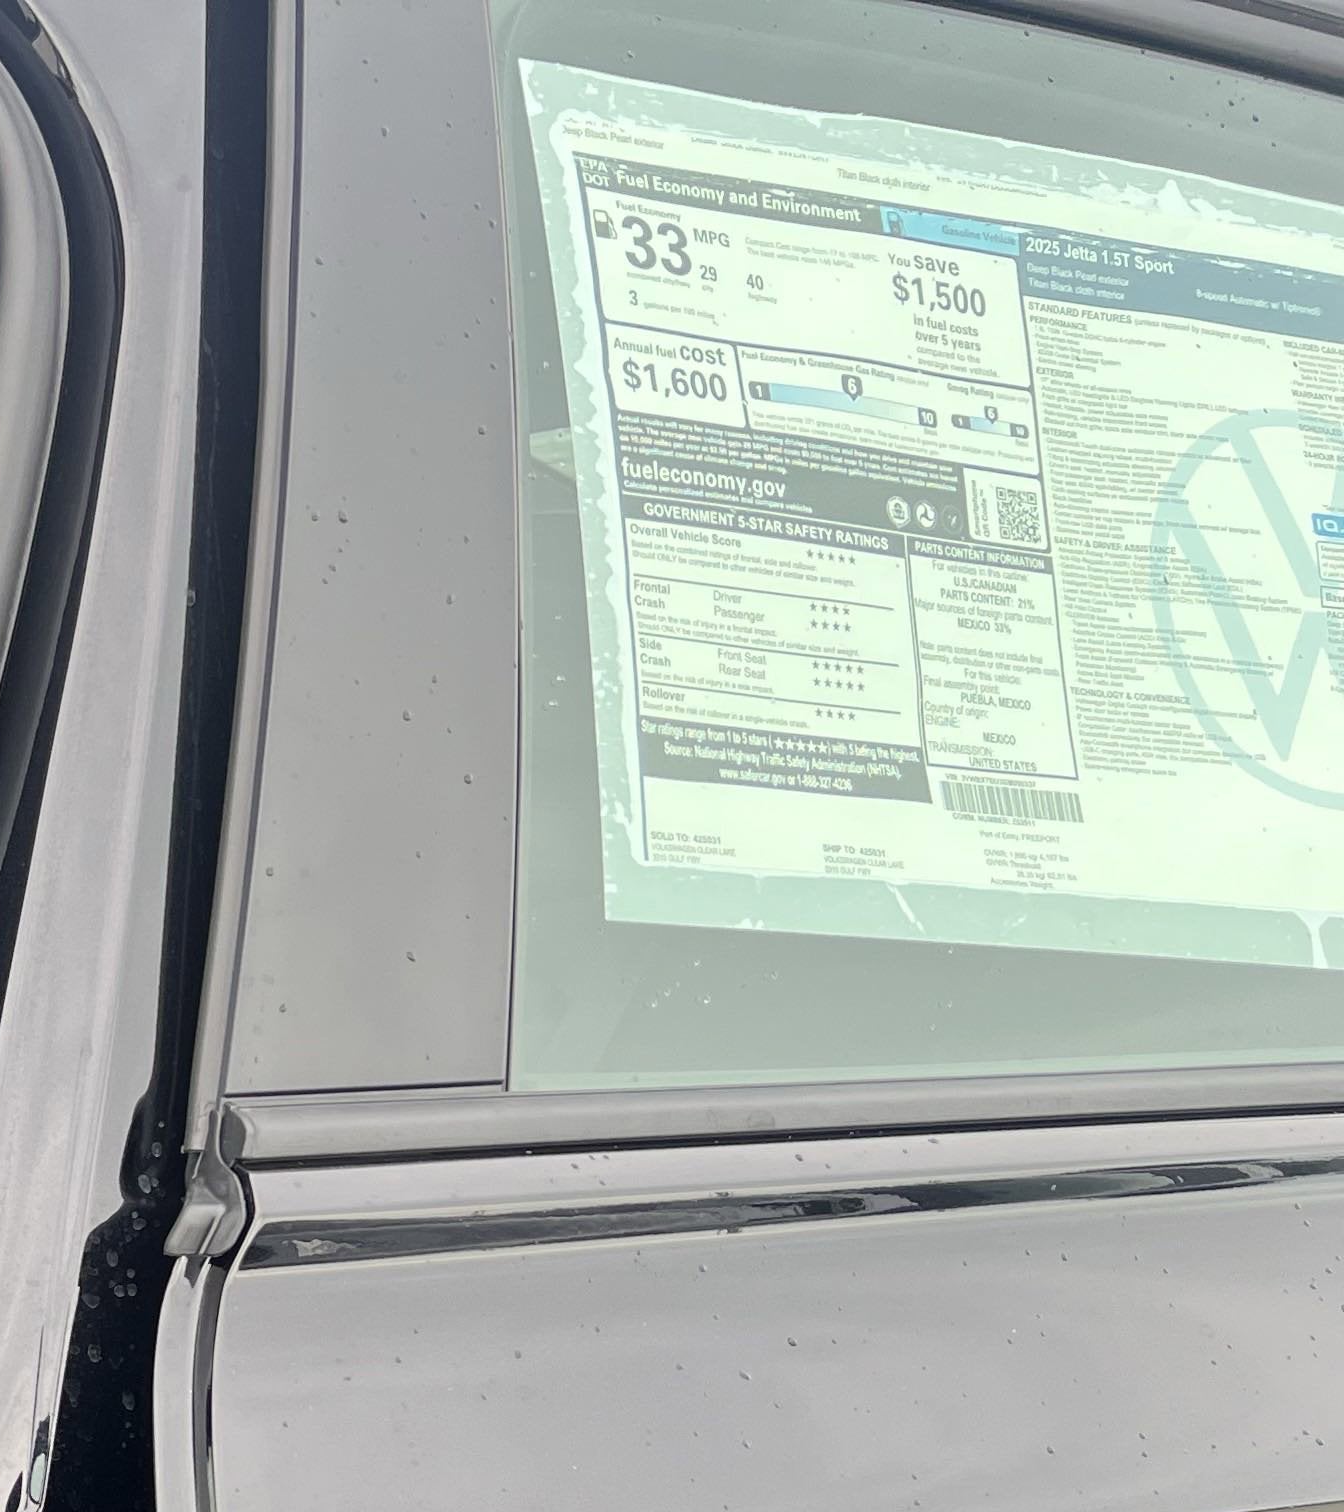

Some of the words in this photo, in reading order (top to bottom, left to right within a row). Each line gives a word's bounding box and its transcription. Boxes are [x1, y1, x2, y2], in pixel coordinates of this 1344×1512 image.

[582, 172, 610, 187] DOT
[858, 171, 880, 185] Black
[616, 169, 650, 190] Fuel
[653, 176, 725, 206] Economy
[728, 189, 757, 208] and
[761, 194, 863, 223] Environment
[615, 201, 636, 213] Fuel
[637, 205, 682, 222] Economy
[692, 227, 731, 248] MPG
[941, 224, 981, 241] Gasoline
[622, 215, 693, 276] 33
[887, 252, 911, 268] You
[914, 255, 960, 277] save
[1025, 237, 1061, 257] 2025
[1063, 243, 1098, 263] Jetta
[1101, 249, 1130, 268] 1.5T
[1134, 254, 1175, 276] Sport
[698, 263, 718, 282] 29
[745, 273, 764, 291] 40
[628, 289, 639, 307] 3
[891, 270, 986, 318] $1,500
[1027, 301, 1080, 319] STANDARD
[1081, 308, 1132, 325] FEATURES
[926, 316, 947, 331] fuel
[949, 323, 979, 337] costs
[915, 330, 938, 344] over
[951, 336, 982, 352] years
[613, 336, 653, 355] Annual
[655, 344, 677, 358] fuel
[679, 345, 727, 367] cost
[622, 356, 727, 403] $1,600
[847, 379, 857, 394] 6
[921, 411, 933, 425] 10
[621, 456, 787, 498] fueleconomy.gov
[642, 502, 735, 526] GOVERNMENT
[736, 516, 782, 533] 5-STAR
[784, 523, 833, 541] SAFETY
[835, 530, 890, 550] RATINGS
[629, 523, 669, 538] Overall
[670, 529, 709, 544] Vehicle
[711, 534, 743, 549] Score
[914, 541, 944, 556] PARTS
[946, 544, 983, 562] CONTENT
[984, 549, 1045, 569] INFORMATION
[633, 579, 671, 596] Frontal
[953, 576, 1017, 594] U.S./CANADIAN
[634, 595, 666, 610] Crash
[712, 590, 743, 605] Driver
[940, 588, 969, 602] PARTS
[971, 592, 1014, 607] CONTENT:
[1017, 598, 1035, 610] 21%
[713, 605, 765, 624] Passenger
[957, 618, 990, 632] MEXICO
[639, 637, 663, 652] Side
[640, 653, 672, 668] Crash
[717, 648, 742, 663] Front
[743, 651, 767, 666] Seat
[718, 663, 742, 678] Rear
[743, 666, 766, 681] Seat
[642, 686, 686, 703] Rollover
[998, 696, 1032, 711] MEXICO
[969, 757, 1002, 770] UNITED
[1003, 760, 1038, 772] STATES
